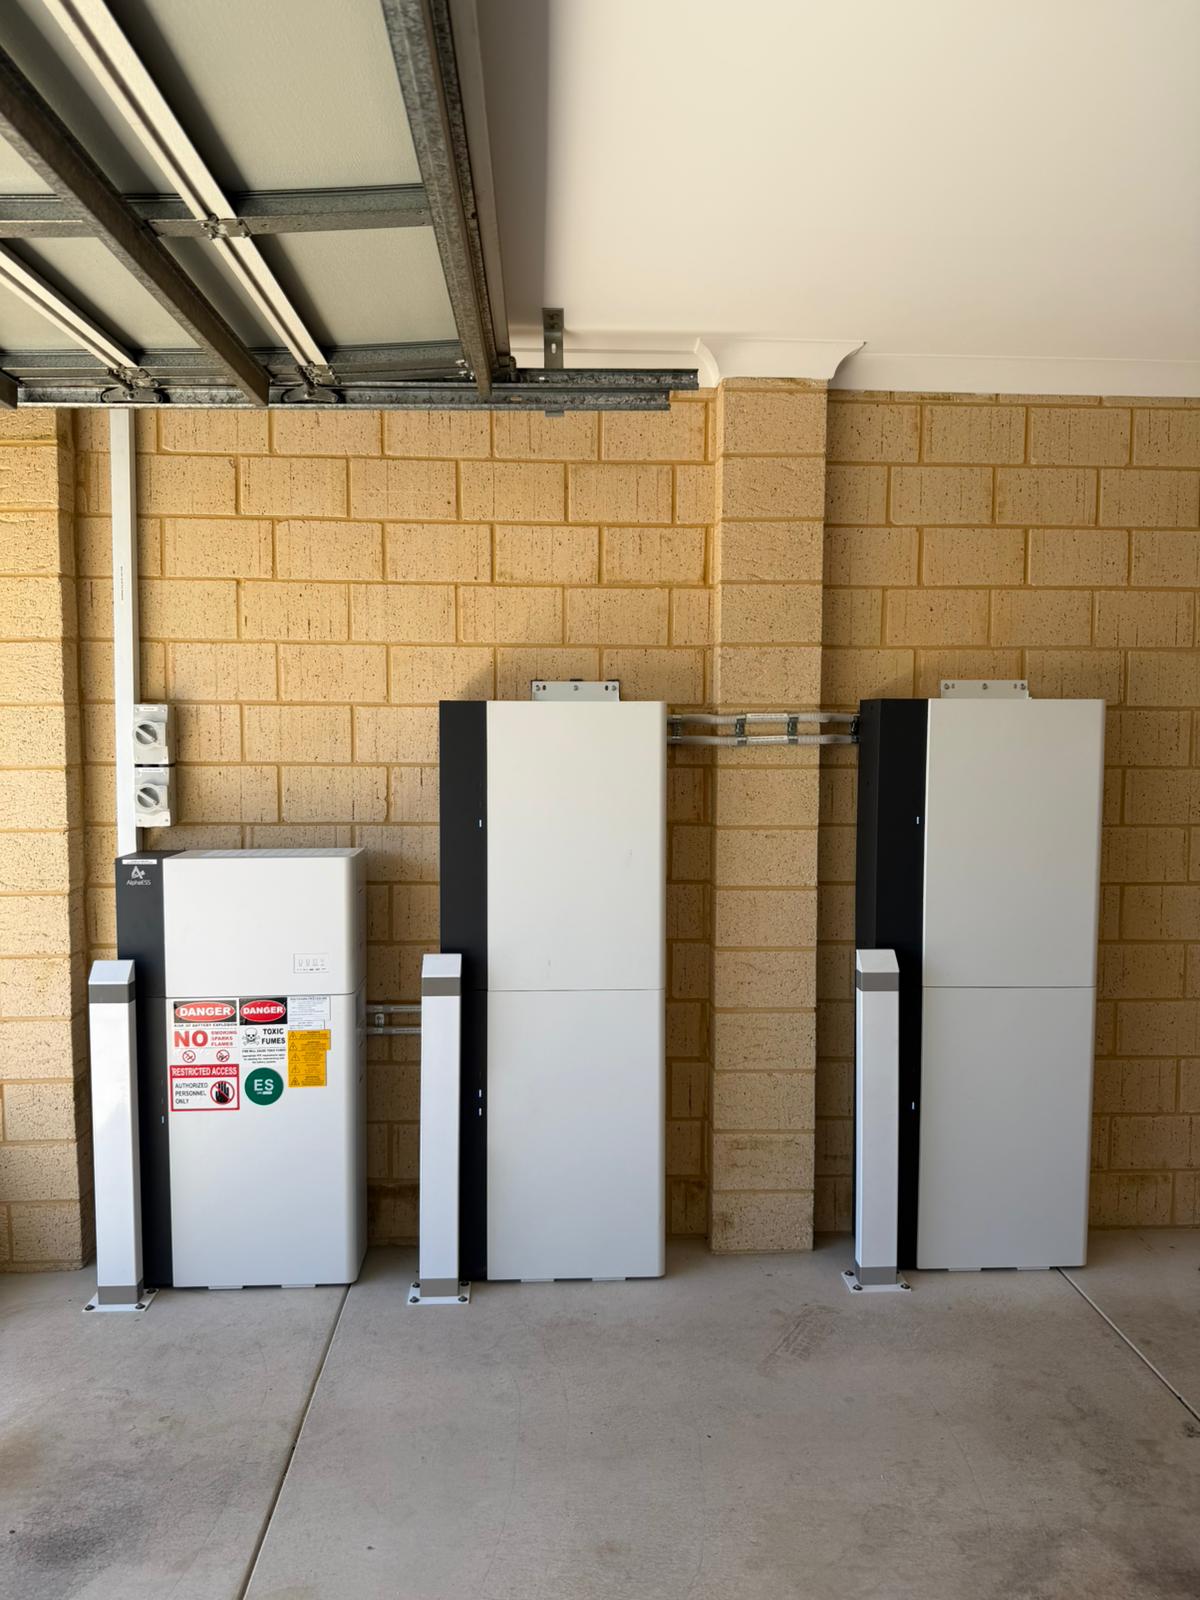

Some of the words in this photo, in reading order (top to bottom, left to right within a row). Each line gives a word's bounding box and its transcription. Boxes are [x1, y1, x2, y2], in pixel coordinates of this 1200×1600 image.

[180, 1007, 230, 1016] DANGER
[244, 1006, 284, 1014] DANGER
[174, 1030, 208, 1047] NO
[172, 1068, 210, 1076] RESTRICTED
[212, 1066, 237, 1075] ACCESS
[254, 1079, 274, 1091] ES
